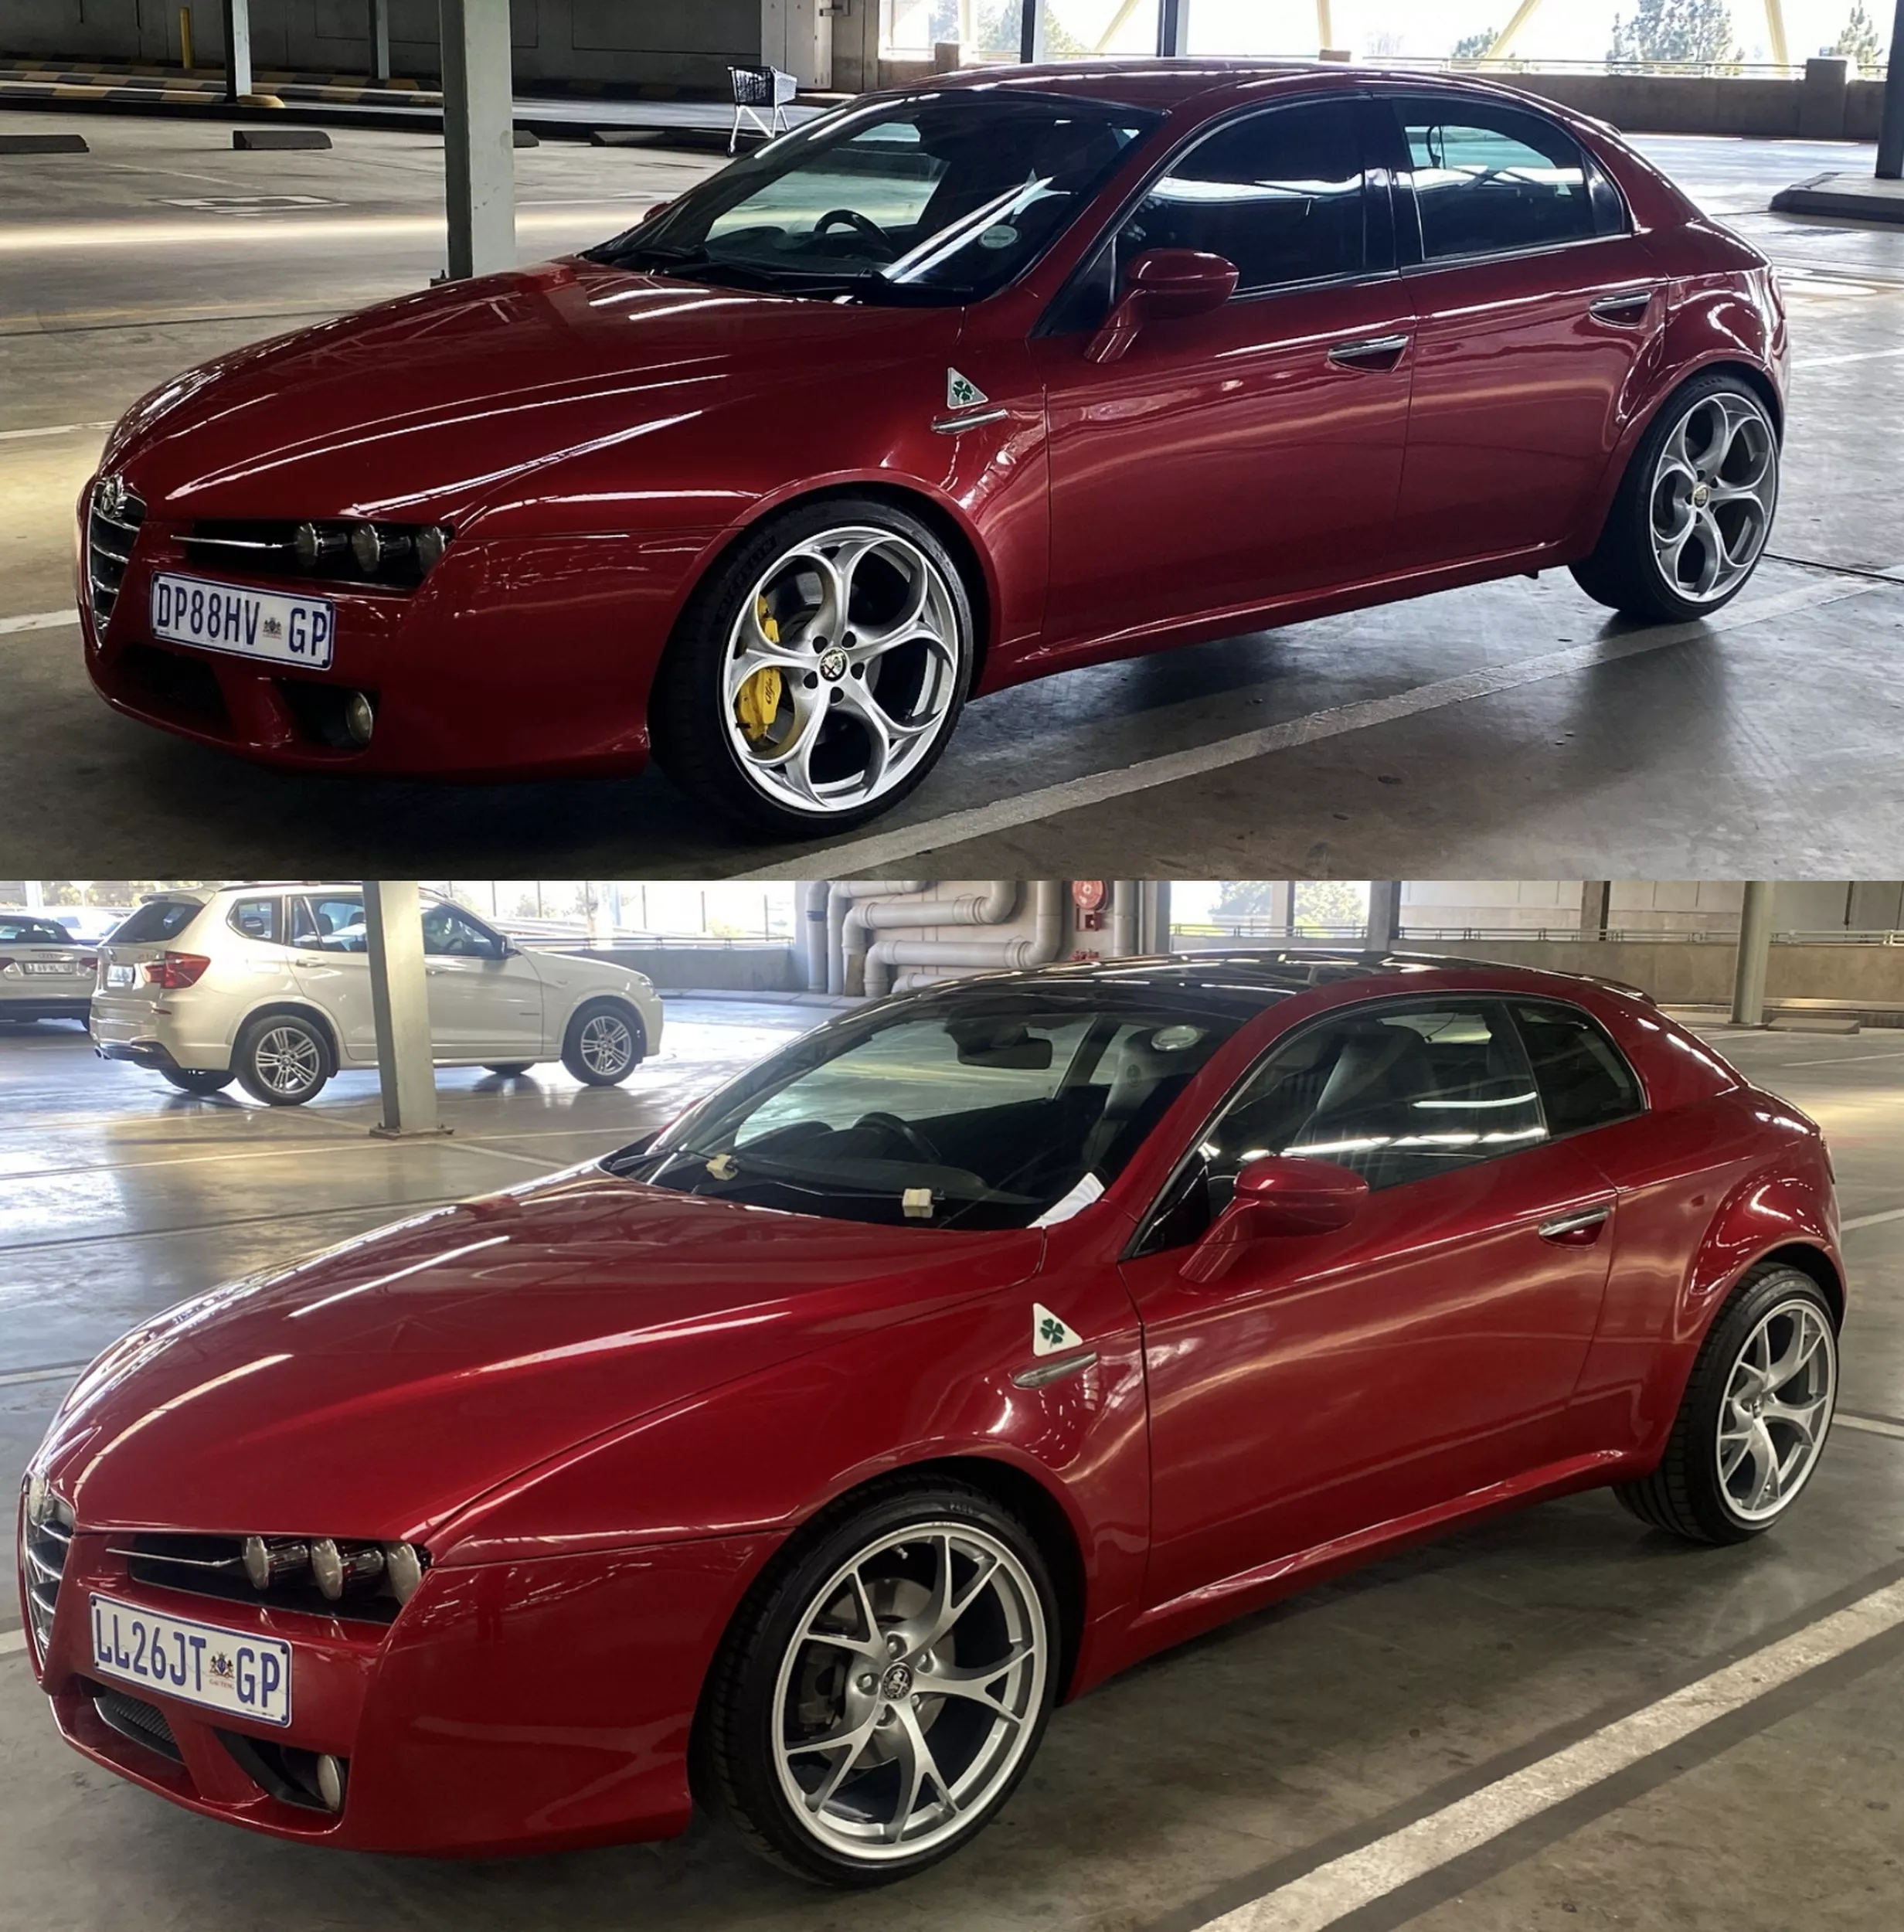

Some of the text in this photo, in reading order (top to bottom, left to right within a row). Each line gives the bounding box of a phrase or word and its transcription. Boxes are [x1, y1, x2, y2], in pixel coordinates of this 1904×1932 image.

[158, 583, 327, 656] DP88HV GP
[95, 1609, 280, 1708] LL26JT GP
